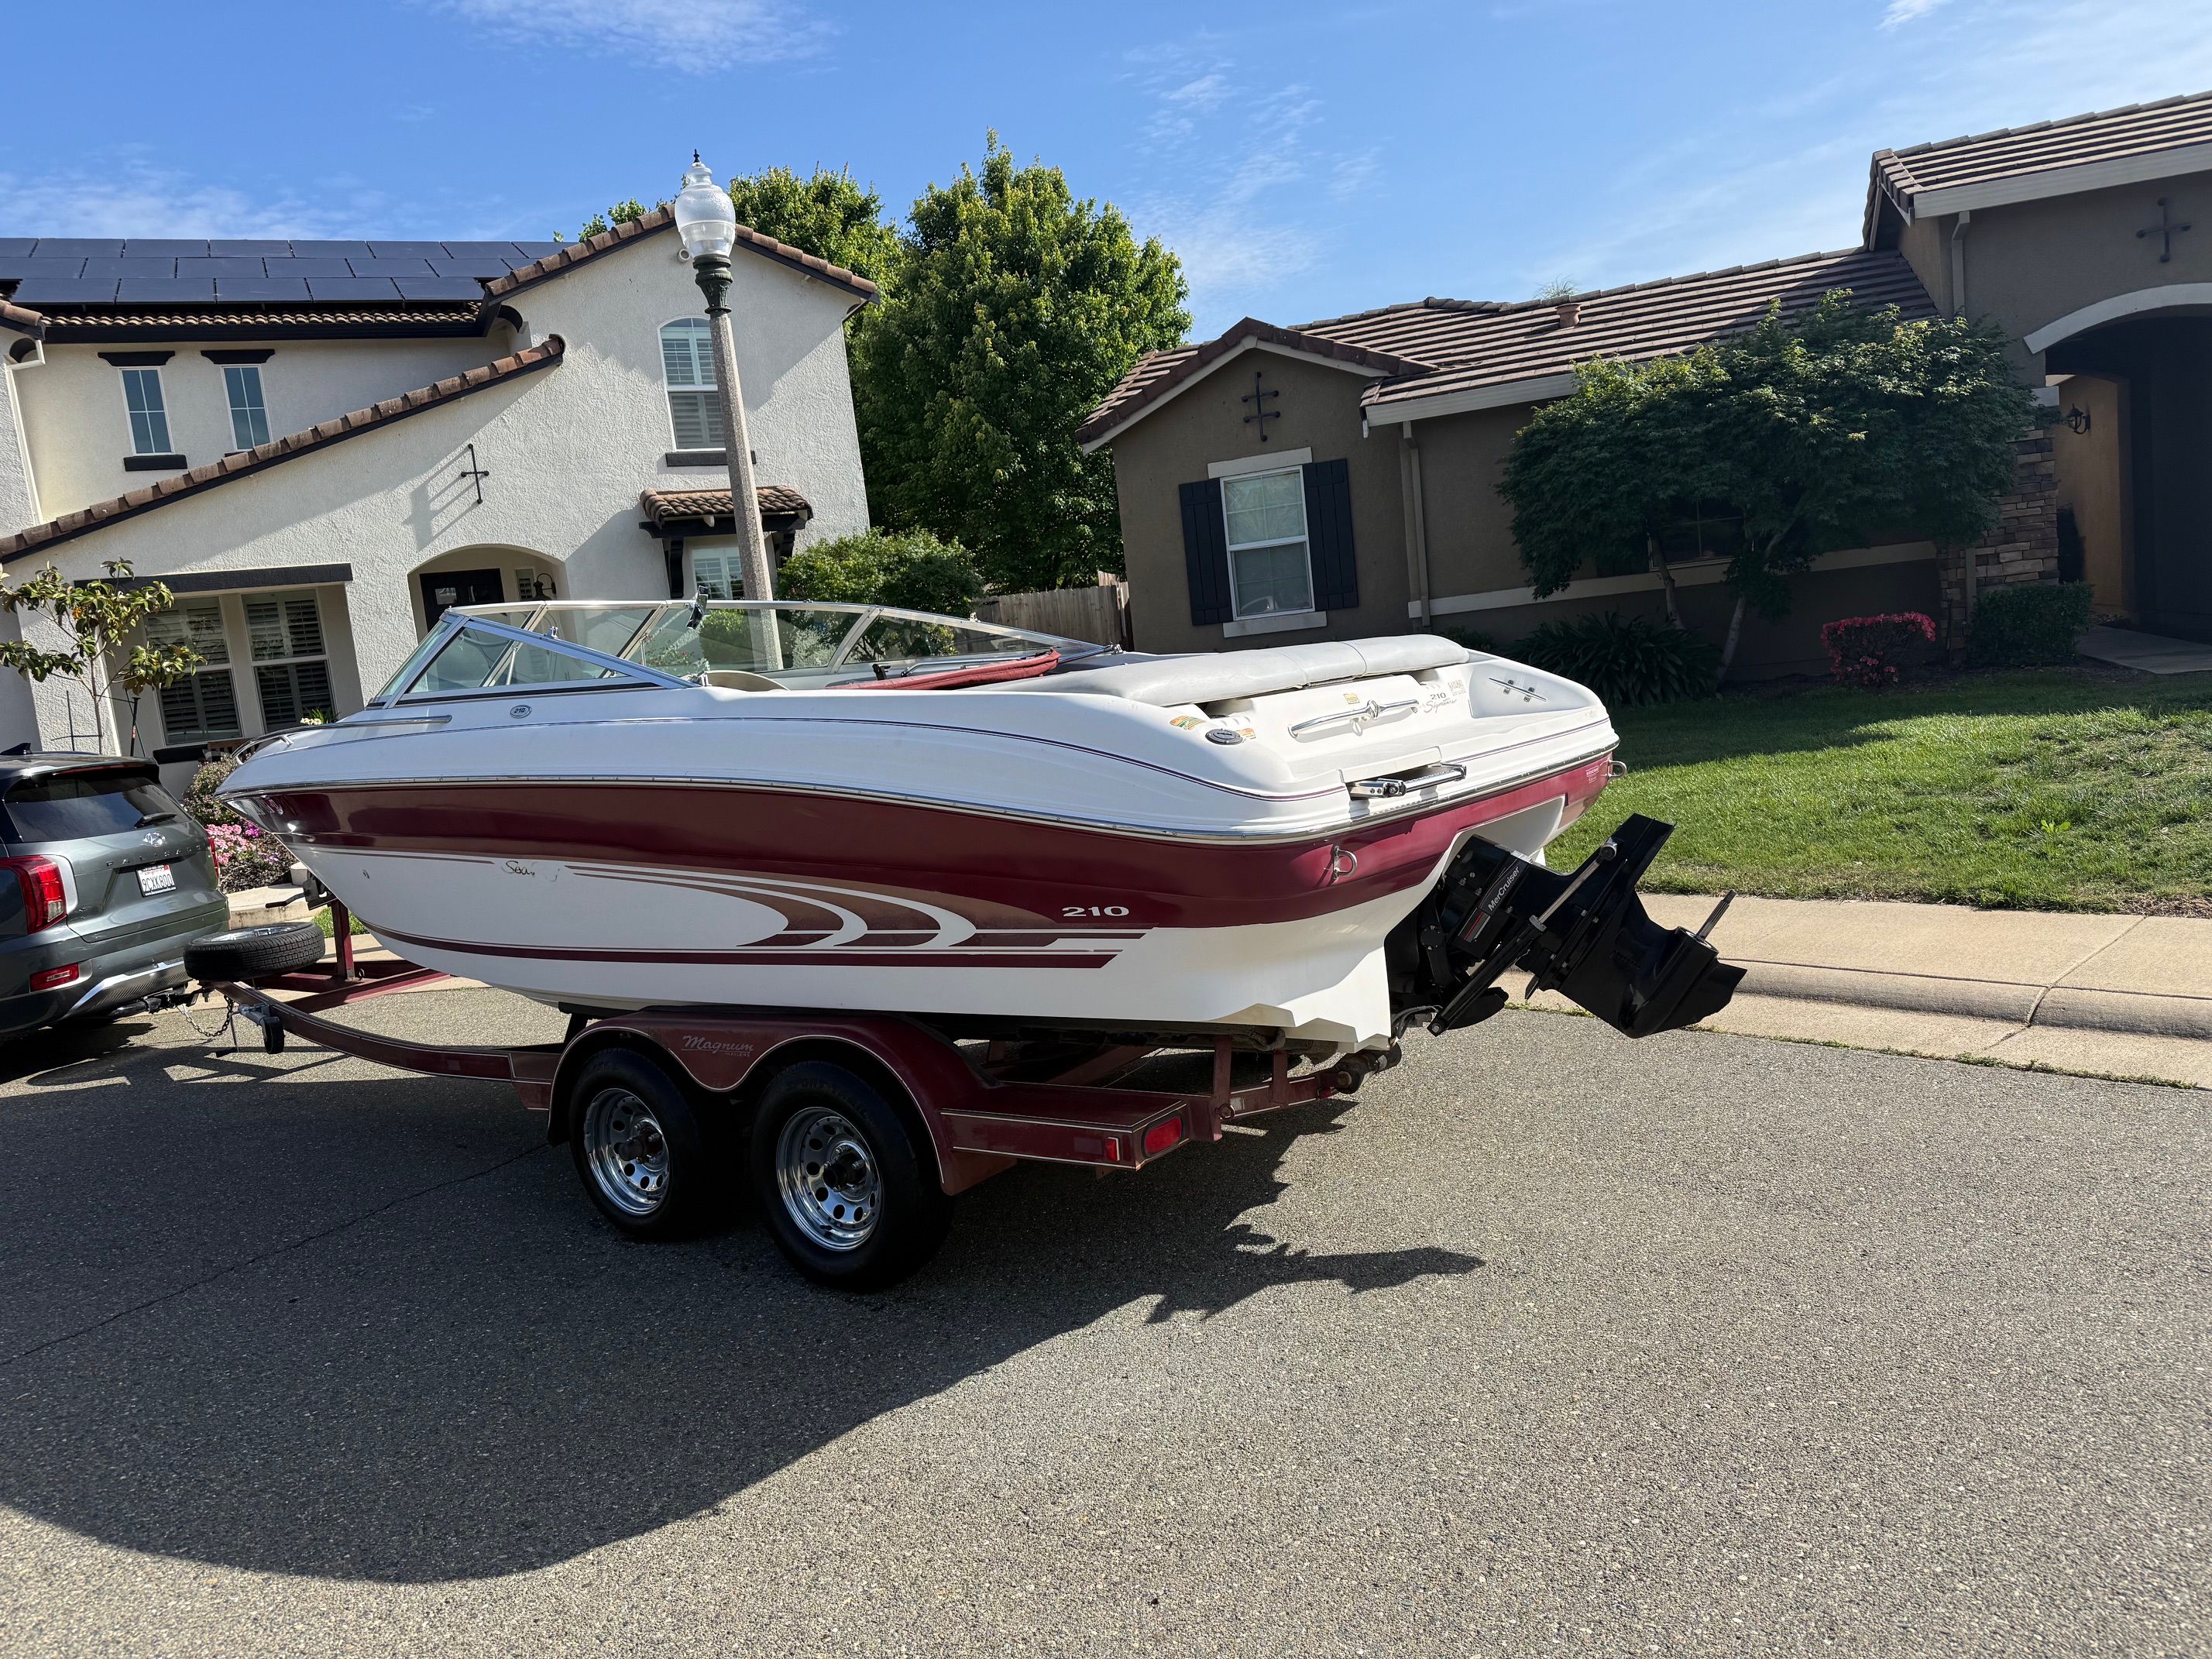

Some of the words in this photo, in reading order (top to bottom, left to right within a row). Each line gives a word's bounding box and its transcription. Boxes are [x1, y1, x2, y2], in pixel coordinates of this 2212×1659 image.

[142, 874, 173, 891] 9CXK800
[1488, 866, 1520, 911] MerCruiser
[1061, 905, 1129, 916] 210
[682, 1035, 754, 1054] Magnum
